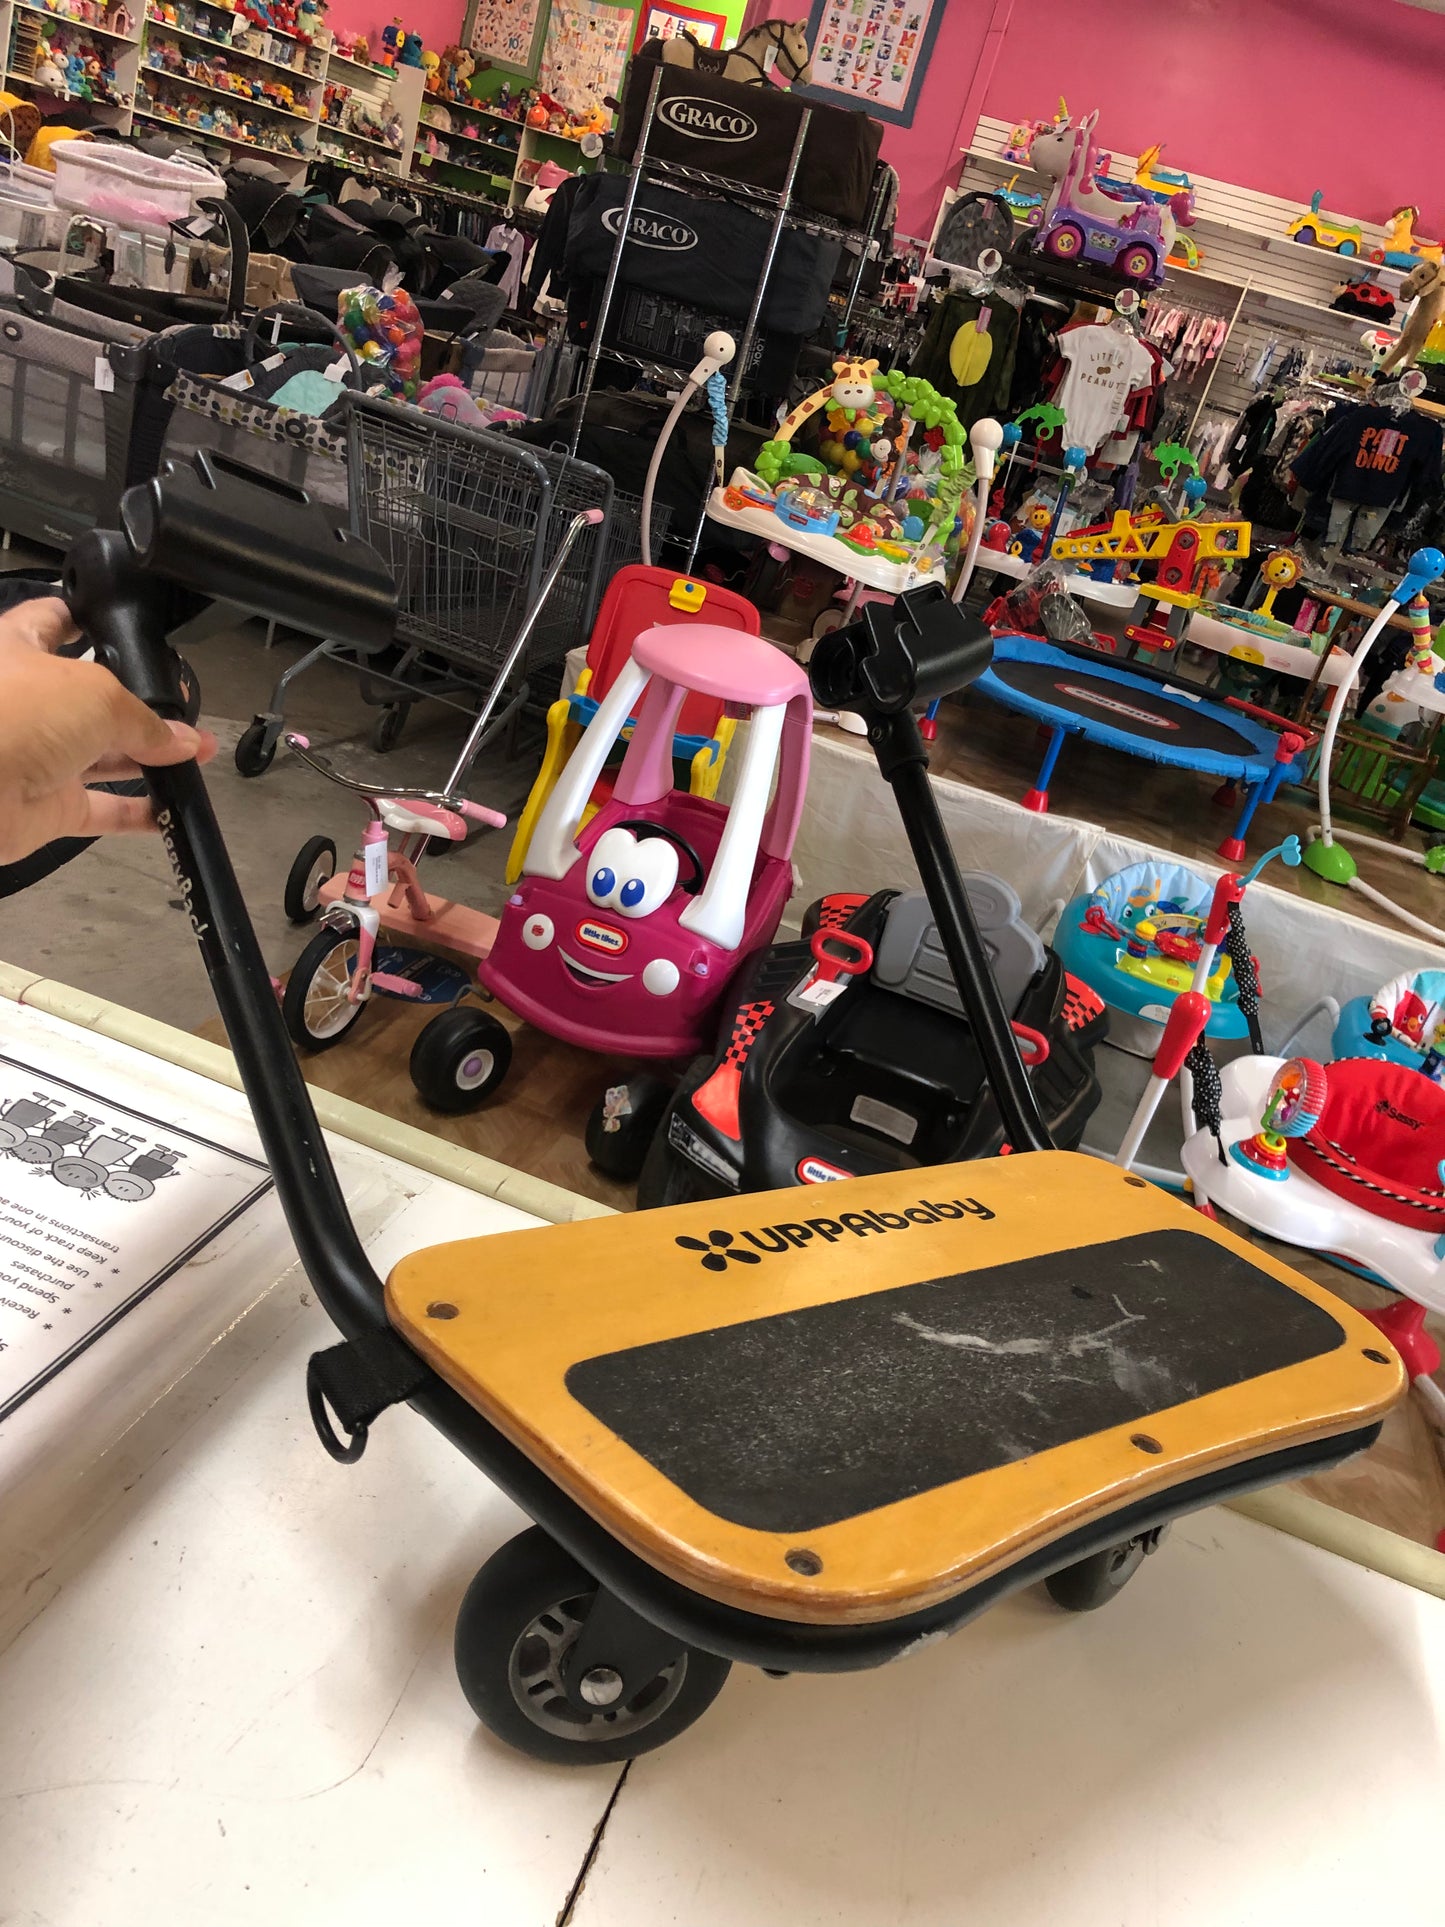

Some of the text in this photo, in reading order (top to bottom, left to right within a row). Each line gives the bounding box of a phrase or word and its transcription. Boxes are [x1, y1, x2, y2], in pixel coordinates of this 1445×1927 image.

[669, 102, 749, 135] GRACO
[752, 337, 766, 366] LOOK
[1090, 352, 1124, 369] LITTE
[1080, 372, 1121, 390] PEANUT
[1360, 427, 1409, 456] PAT
[583, 927, 600, 939] little
[807, 1166, 827, 1181] little
[11, 1202, 34, 1216] one
[35, 1213, 48, 1224] in
[739, 1197, 996, 1253] UPPAbaby
[26, 1226, 44, 1236] of
[48, 1218, 120, 1254] transactions
[44, 1233, 75, 1251] track
[43, 1253, 66, 1267] the
[77, 1246, 108, 1265] Keep
[10, 1260, 75, 1291] purchases
[66, 1265, 90, 1279] Use
[17, 1282, 61, 1304] Spend
